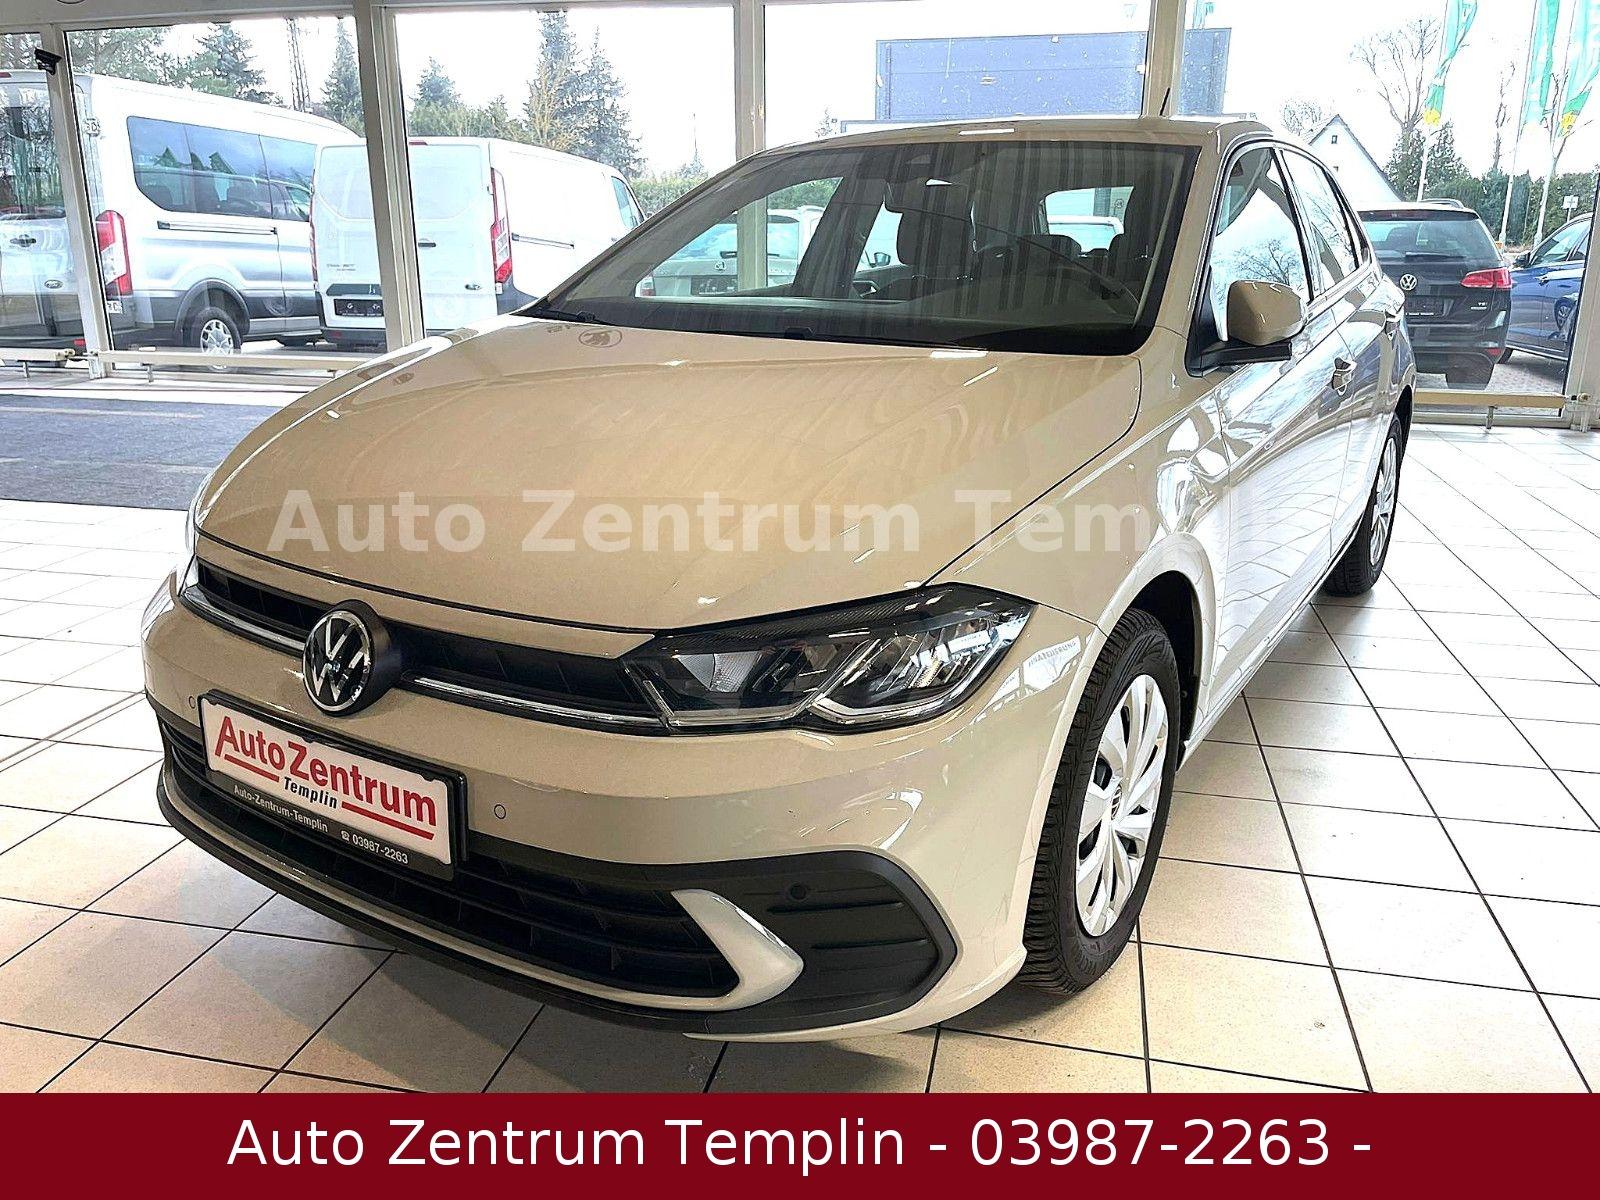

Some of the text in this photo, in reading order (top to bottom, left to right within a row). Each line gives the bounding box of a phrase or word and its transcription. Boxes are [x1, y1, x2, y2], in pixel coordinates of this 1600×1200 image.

[303, 611, 370, 711] VW
[214, 716, 437, 827] AutoZentrum
[283, 777, 338, 809] Templin
[233, 784, 409, 865] Auto-Zentrum-Templin 03987-2263
